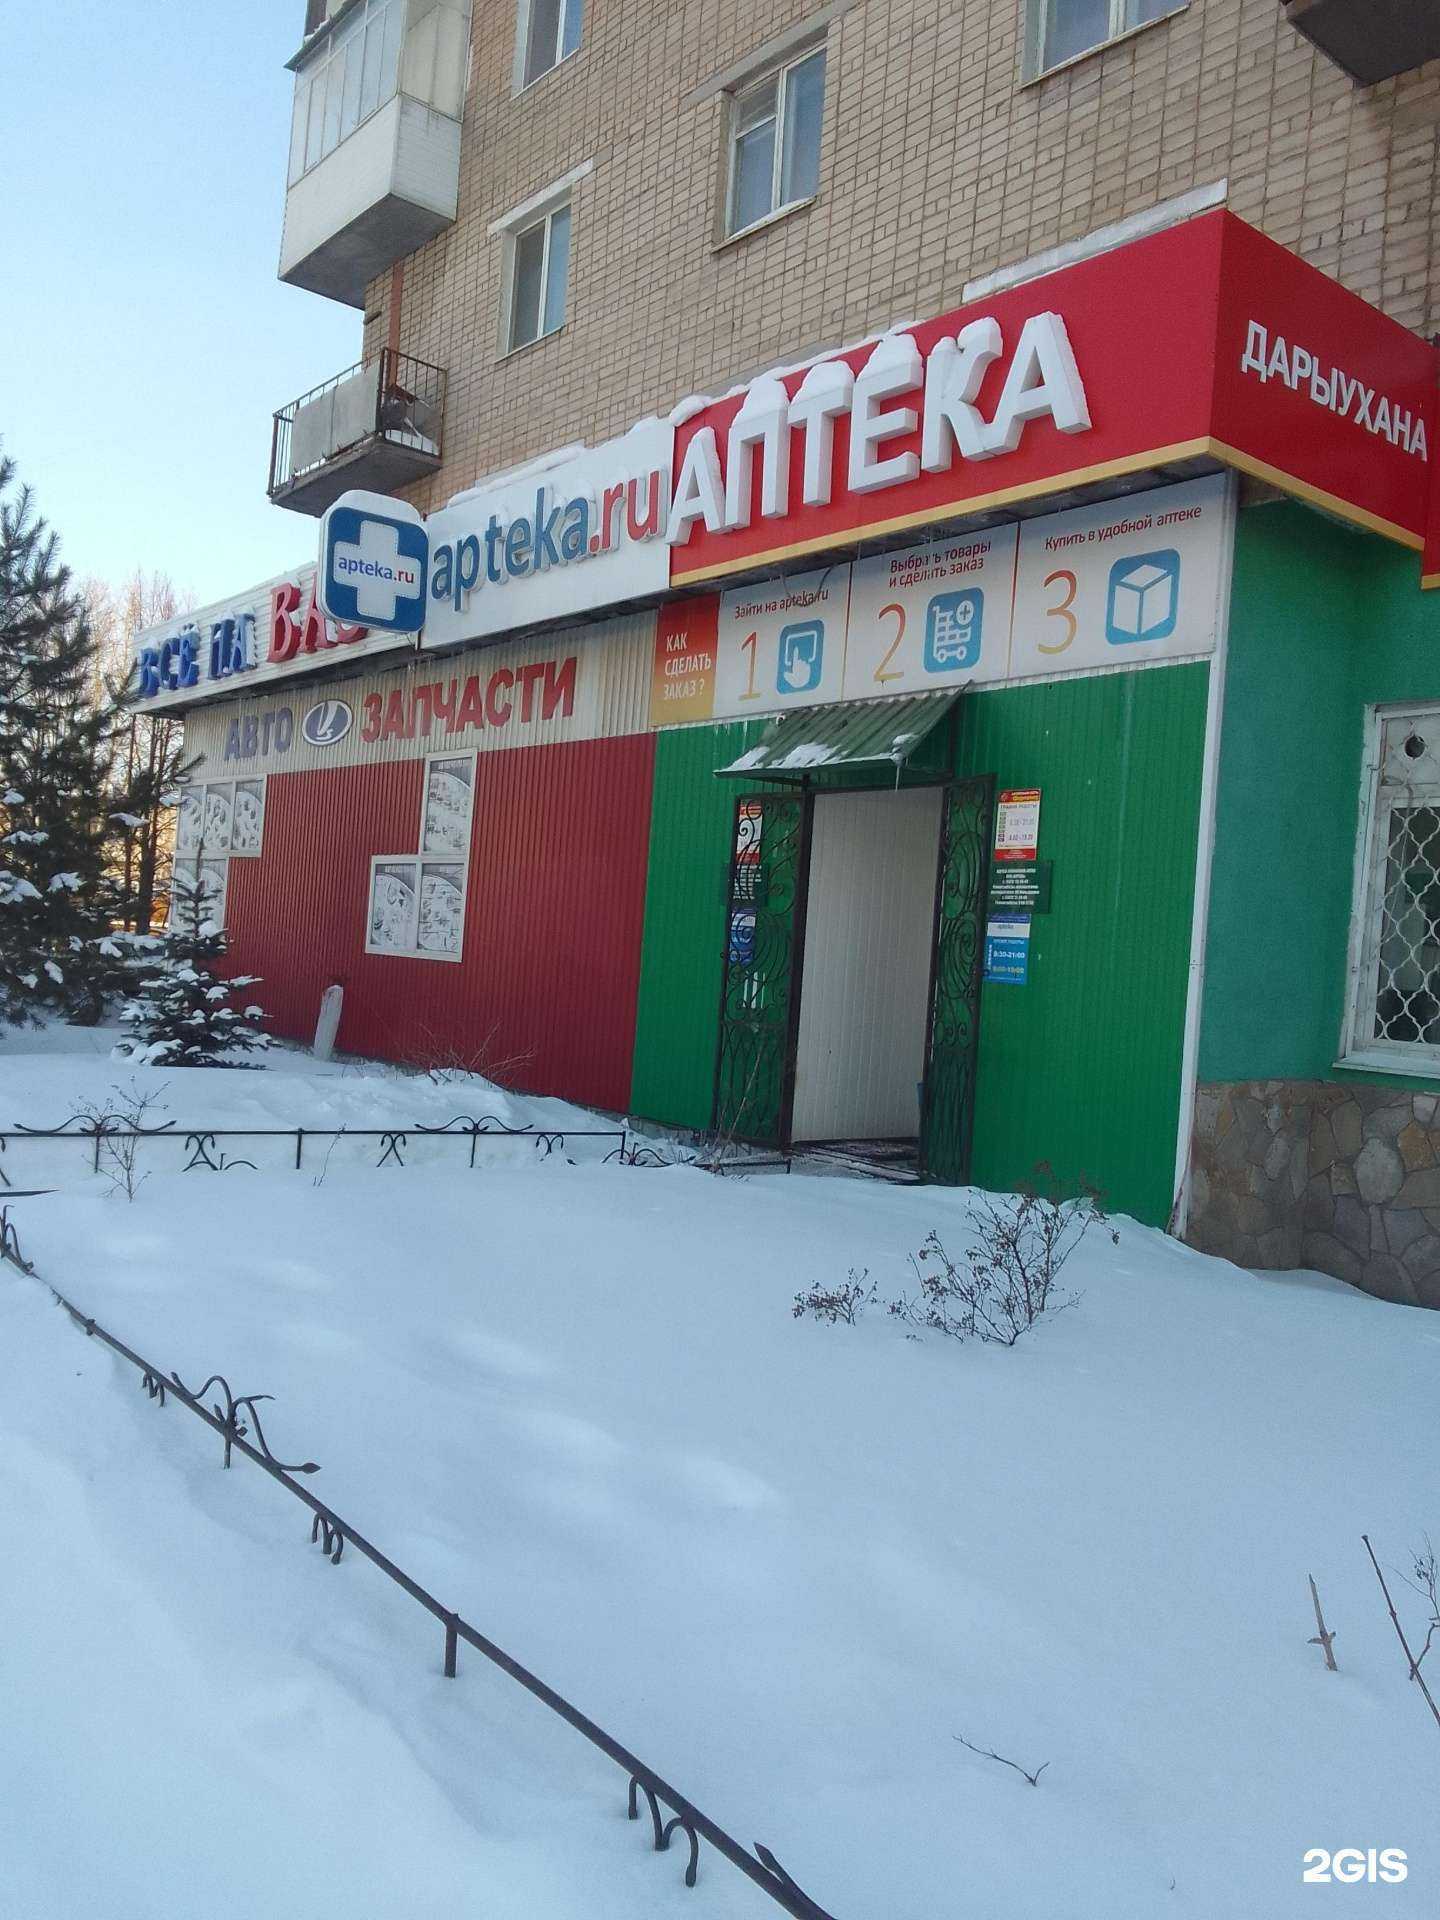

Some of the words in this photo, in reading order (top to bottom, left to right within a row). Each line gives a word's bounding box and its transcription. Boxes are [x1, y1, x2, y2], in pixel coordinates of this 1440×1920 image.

[1240, 319, 1428, 463] ДАРЫУХАНА
[665, 311, 1092, 546] АПТЕКА
[431, 470, 666, 612] apteka.ru
[944, 540, 991, 564] товары
[1045, 531, 1085, 551] Купить
[1088, 530, 1095, 542] в
[1099, 514, 1153, 543] удобной
[1156, 506, 1202, 527] аптеке
[338, 557, 415, 584] apteka.ru
[949, 557, 984, 576] заказ
[266, 571, 369, 663] ВА
[666, 632, 687, 653] КАК
[734, 602, 763, 620] Зайти
[765, 600, 778, 613] на
[873, 603, 906, 681] 2
[1038, 570, 1077, 654] 3
[664, 652, 711, 679] СДЕЛАТЬ
[738, 631, 761, 701] 1
[224, 706, 293, 761] АВТО
[361, 656, 577, 744] ЗАПЧАСТИ
